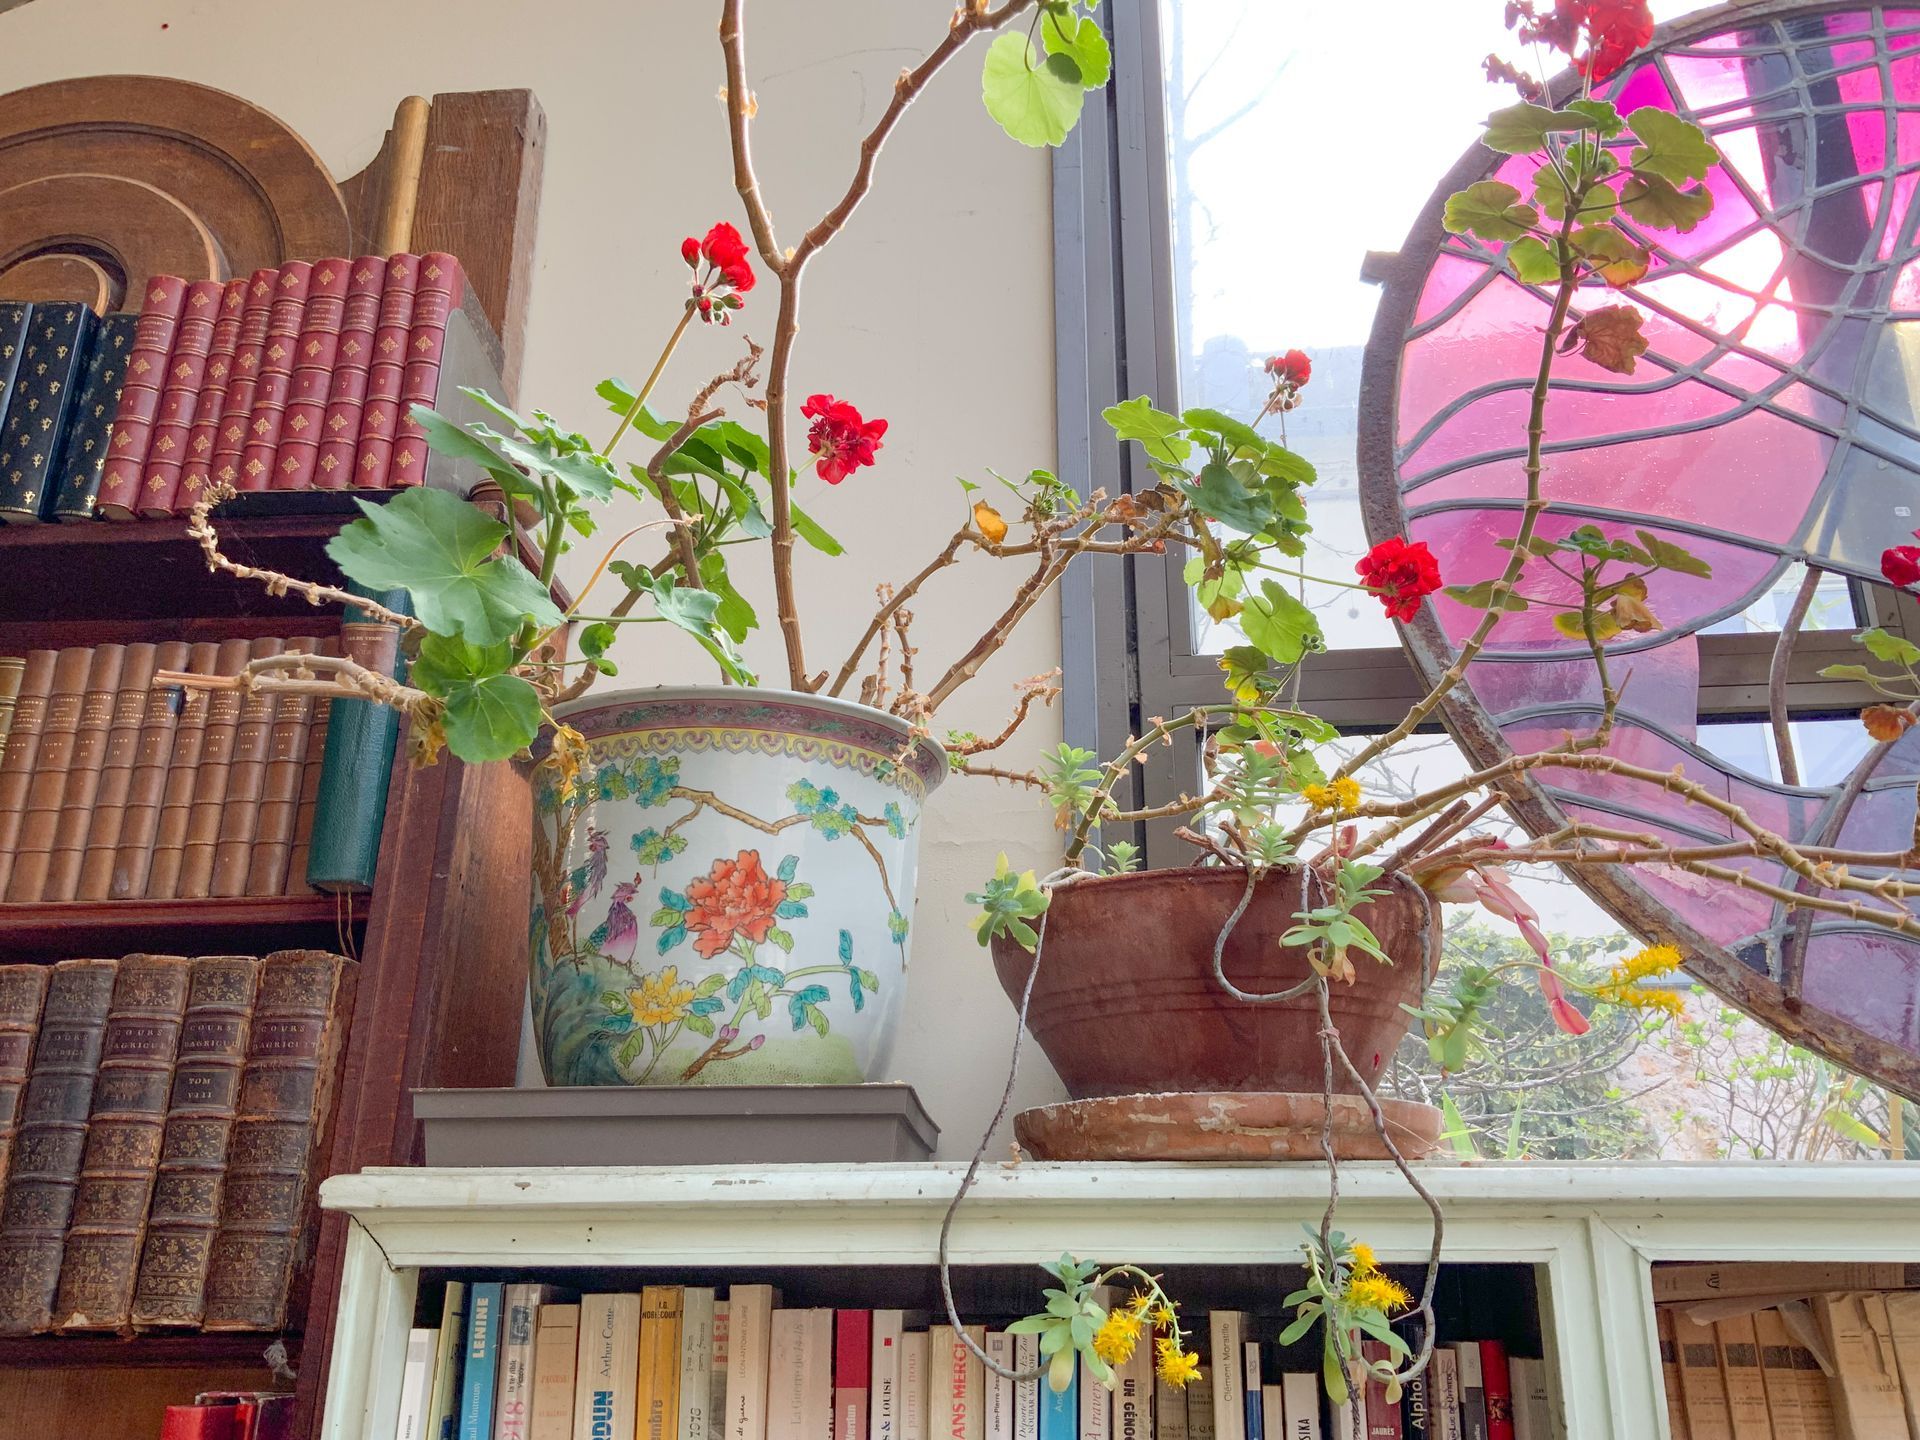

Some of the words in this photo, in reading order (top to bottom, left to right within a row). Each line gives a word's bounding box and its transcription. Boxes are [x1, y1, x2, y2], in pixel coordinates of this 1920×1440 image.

[472, 1298, 489, 1359] LENINE
[953, 1343, 967, 1399] MERCI
[1123, 1379, 1135, 1397] UN
[882, 1378, 892, 1417] LOUISE
[993, 1392, 1001, 1433] Jean-Pierre
[1371, 1426, 1395, 1436] JAURÈS
